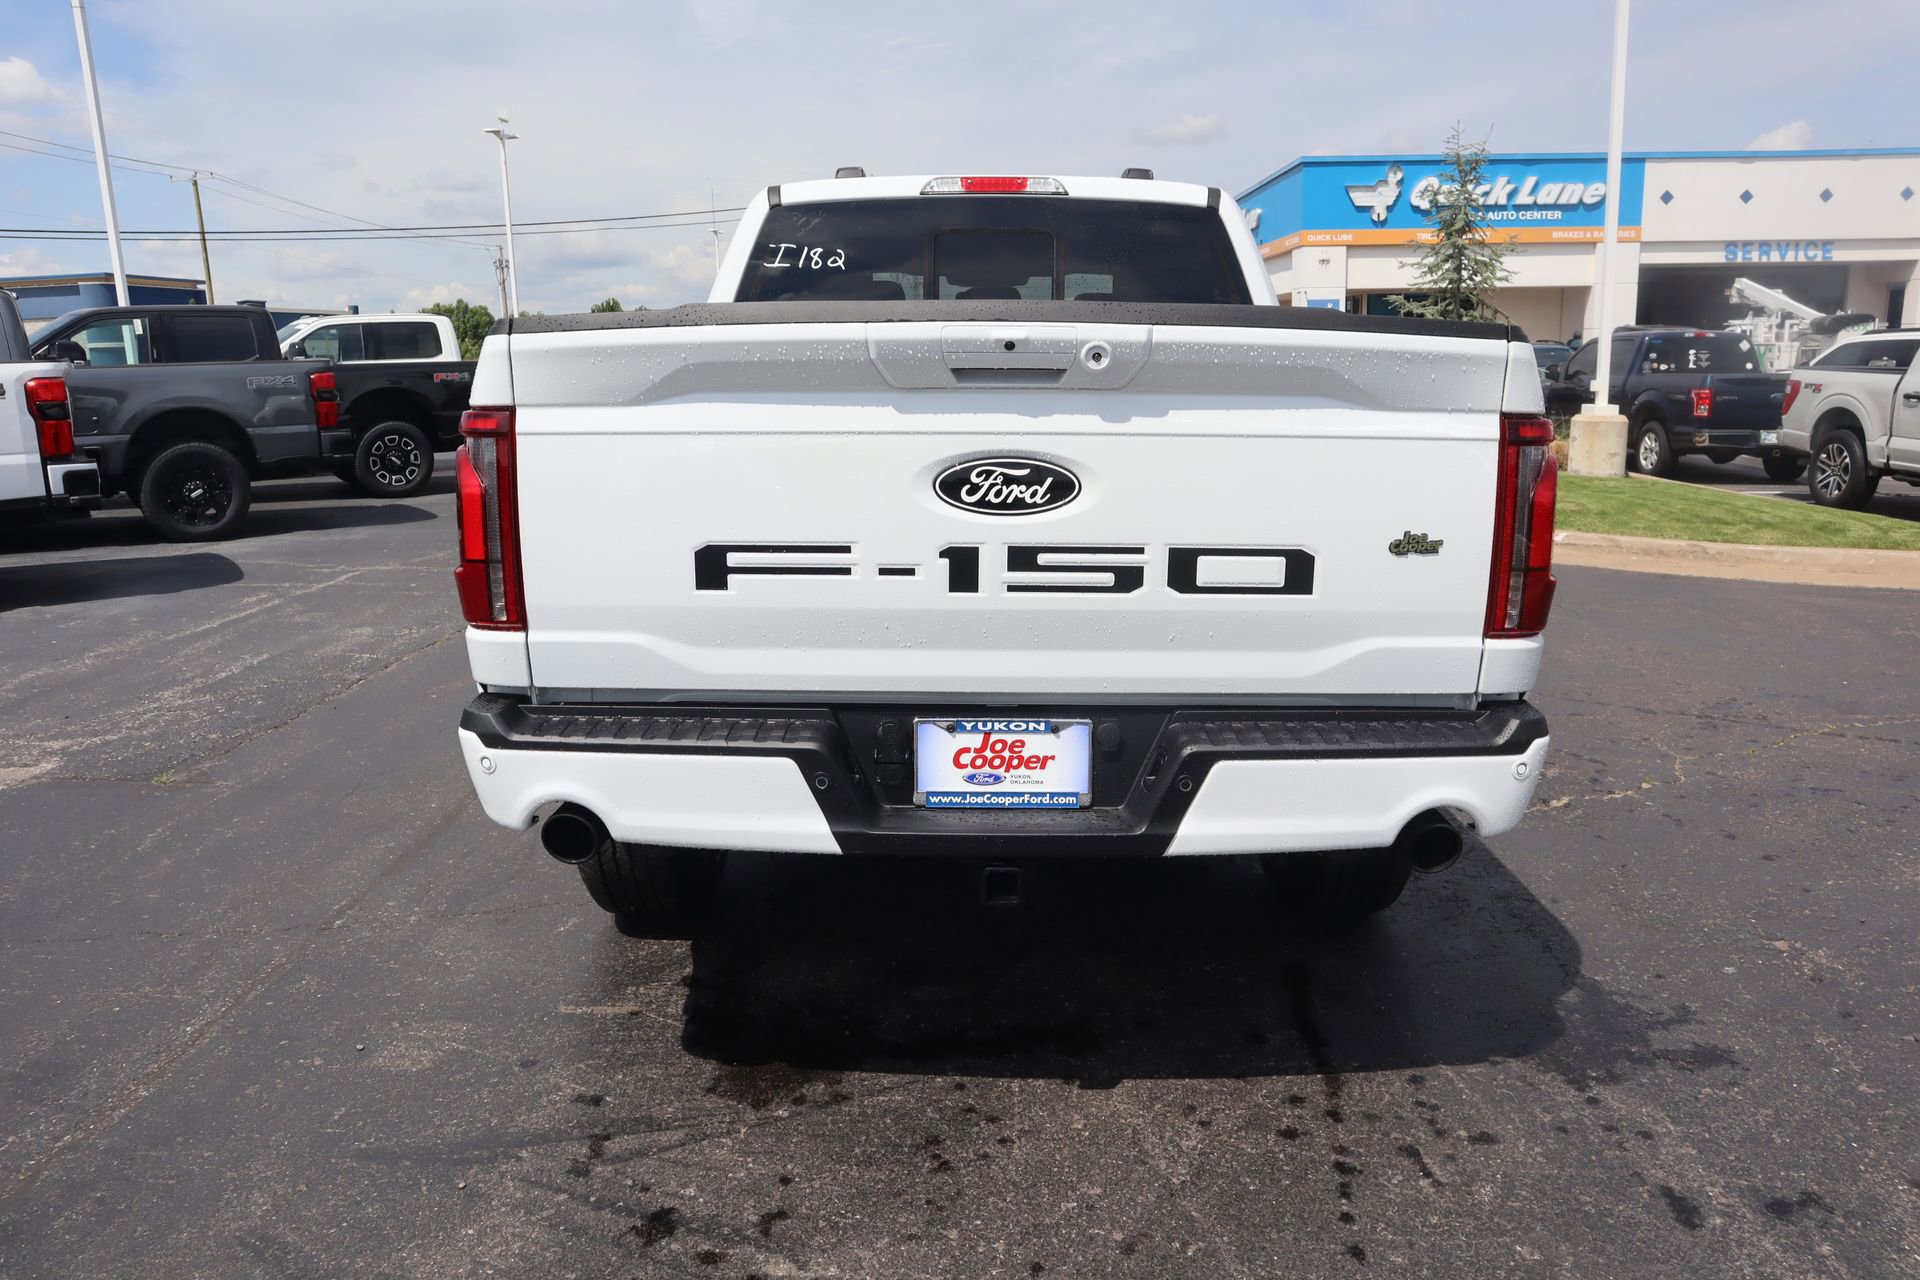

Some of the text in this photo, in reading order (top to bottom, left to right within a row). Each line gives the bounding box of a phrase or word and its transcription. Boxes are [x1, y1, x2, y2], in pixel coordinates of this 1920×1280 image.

[1410, 175, 1606, 211] Quck Lane
[1487, 210, 1517, 221] AUTO
[1518, 210, 1562, 221] CENTER
[1307, 233, 1331, 242] QUICK
[1333, 233, 1353, 242] LUBE
[1552, 231, 1585, 239] BRAKES
[1593, 230, 1637, 239] BARIES
[1725, 241, 1836, 262] SERVICE
[247, 375, 298, 389] FX4
[433, 372, 471, 383] FX4
[960, 465, 1056, 504] Ford
[1402, 530, 1429, 545] Joe
[1388, 539, 1444, 555] Cooper
[694, 543, 1315, 595] F-150
[961, 721, 1046, 731] YUKON
[973, 732, 1026, 755] Joe
[952, 747, 1056, 773] Cooper
[973, 773, 996, 784] Ford
[929, 793, 1077, 807] www.JoeCooperFord.com
